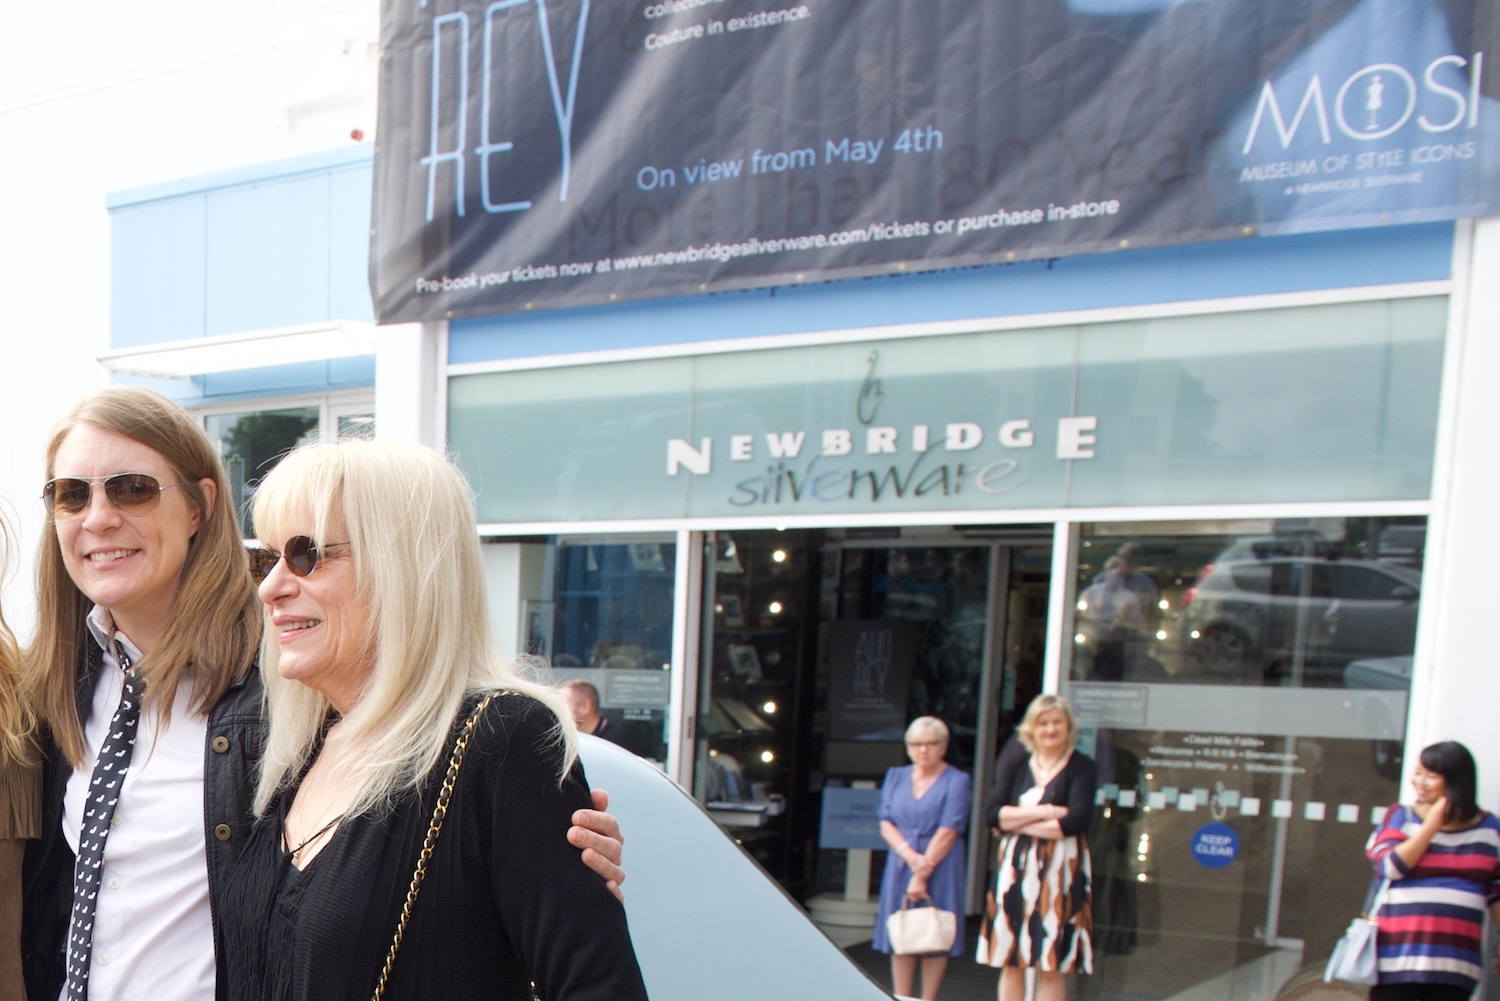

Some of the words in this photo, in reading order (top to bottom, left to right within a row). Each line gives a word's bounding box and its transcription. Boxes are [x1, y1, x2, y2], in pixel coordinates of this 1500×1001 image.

[644, 22, 703, 50] Couture
[707, 19, 723, 35] in
[727, 4, 811, 32] existence.
[1242, 52, 1483, 155] MOSI
[636, 165, 675, 191] On
[683, 157, 744, 184] view
[751, 147, 816, 175] from
[825, 137, 884, 165] May
[893, 124, 943, 154] 4th
[1239, 160, 1317, 183] MUSEUM
[1322, 155, 1350, 173] OF
[1355, 149, 1404, 170] STYLE
[1410, 142, 1476, 164] ICONS
[416, 275, 478, 293] Pre-book
[479, 270, 510, 288] your
[512, 264, 558, 282] tickets
[559, 261, 594, 278] now
[595, 259, 612, 273] at
[613, 221, 930, 271] www.newbridgesilverware.com/tickets
[932, 219, 955, 235] or
[957, 209, 1043, 236] purchase
[1047, 199, 1120, 221] in-store
[666, 416, 1098, 476] NEWBRIDGE
[1194, 844, 1234, 856] CLEAR
[1202, 833, 1232, 845] KEEP
